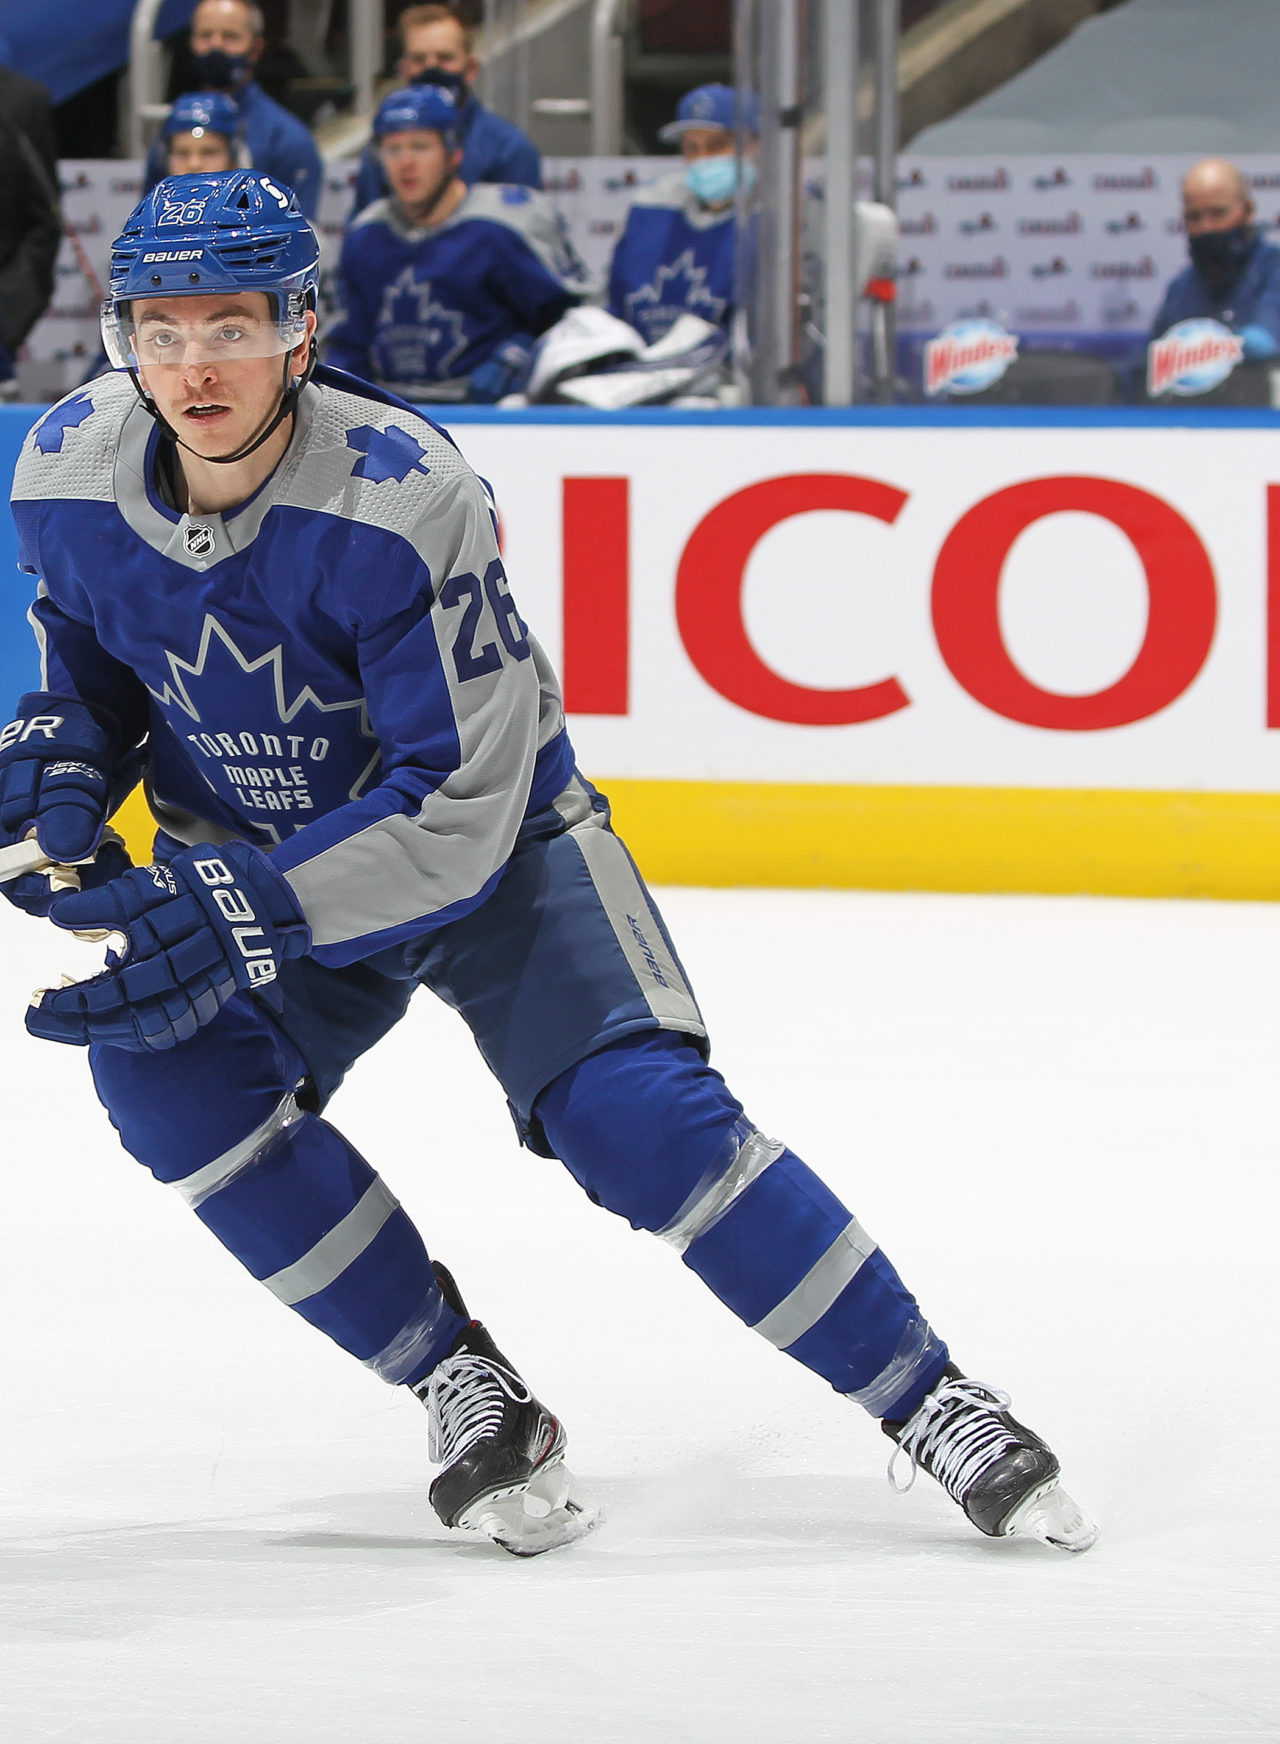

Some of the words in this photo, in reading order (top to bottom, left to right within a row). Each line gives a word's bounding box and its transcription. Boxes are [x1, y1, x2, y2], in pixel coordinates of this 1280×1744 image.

[157, 200, 206, 227] 26
[142, 250, 204, 263] BAUER
[190, 533, 208, 550] NHL
[498, 470, 1280, 732] ICO
[438, 557, 531, 684] 26
[187, 731, 330, 761] TORONTO
[223, 764, 309, 787] MAPLE
[235, 787, 314, 811] LEAFS
